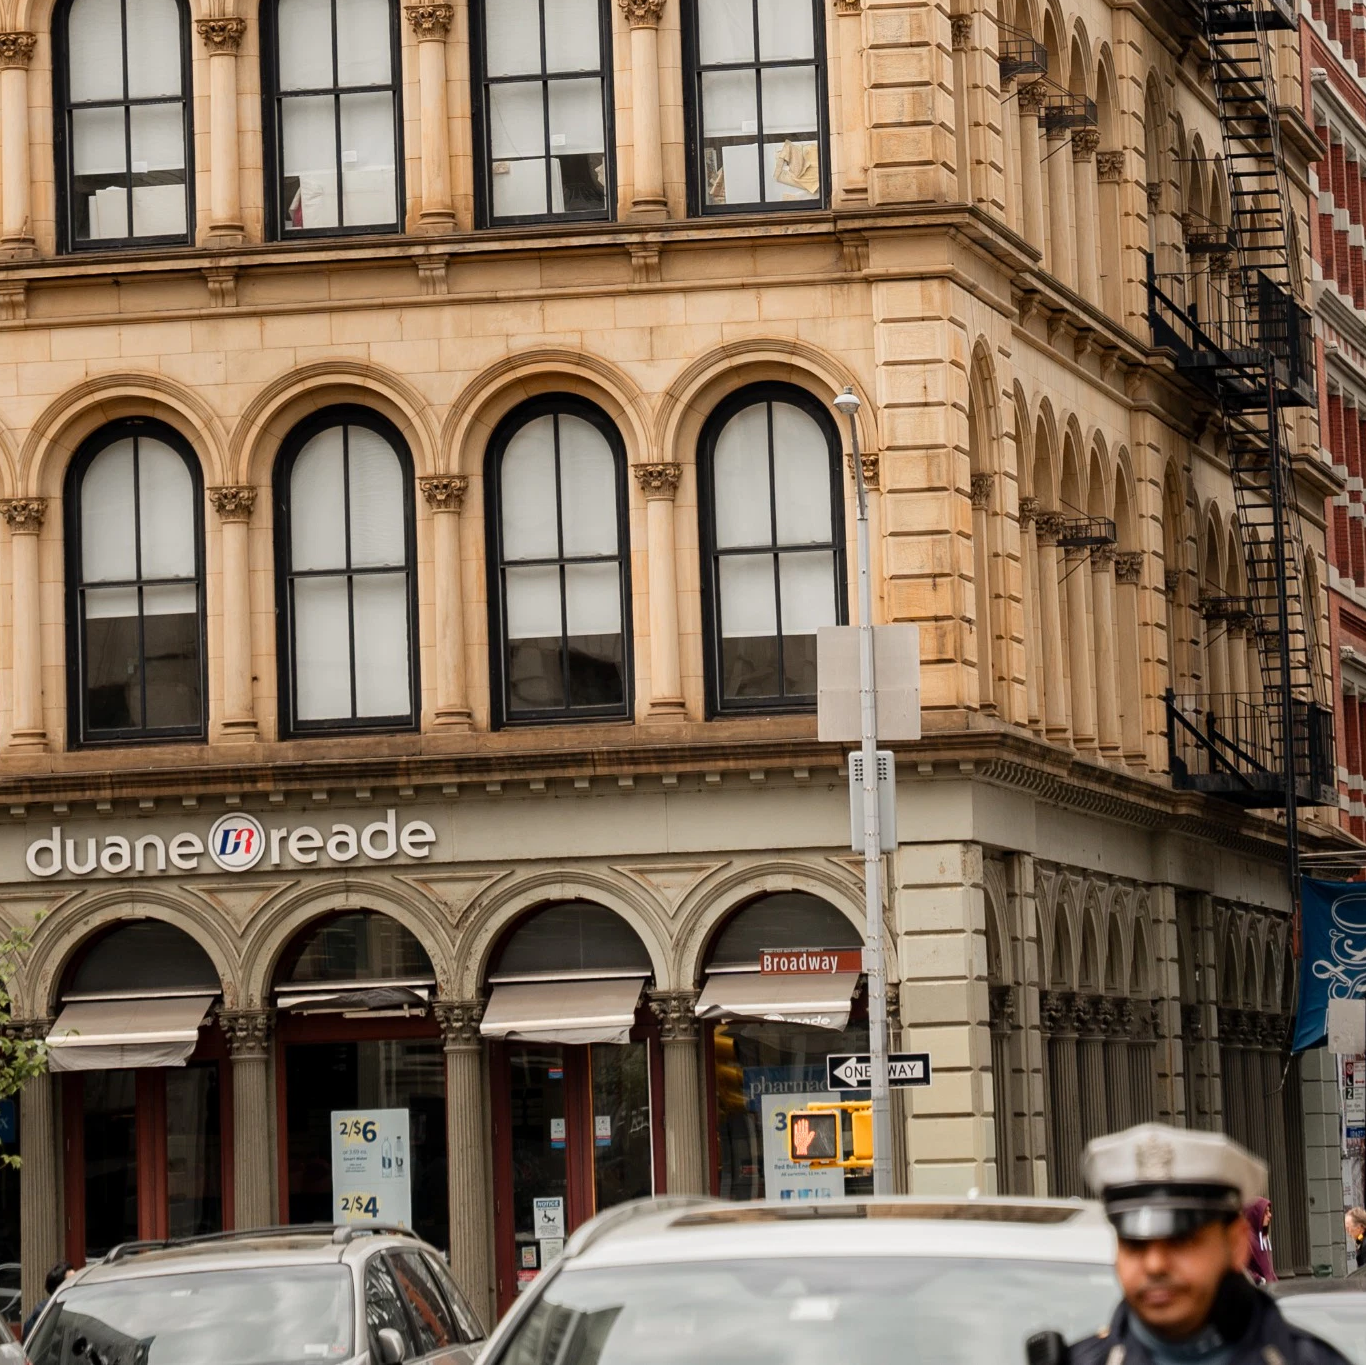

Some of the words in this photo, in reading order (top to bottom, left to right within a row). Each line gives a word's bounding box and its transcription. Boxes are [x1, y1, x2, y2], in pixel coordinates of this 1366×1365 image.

[26, 826, 204, 877] duane
[270, 809, 436, 864] reade
[763, 953, 838, 974] Broadway
[844, 1065, 871, 1078] ONE
[888, 1063, 917, 1078] WAY
[749, 1075, 828, 1099] pharmac
[339, 1120, 377, 1143] 2/$6
[341, 1195, 379, 1218] 2/$4
